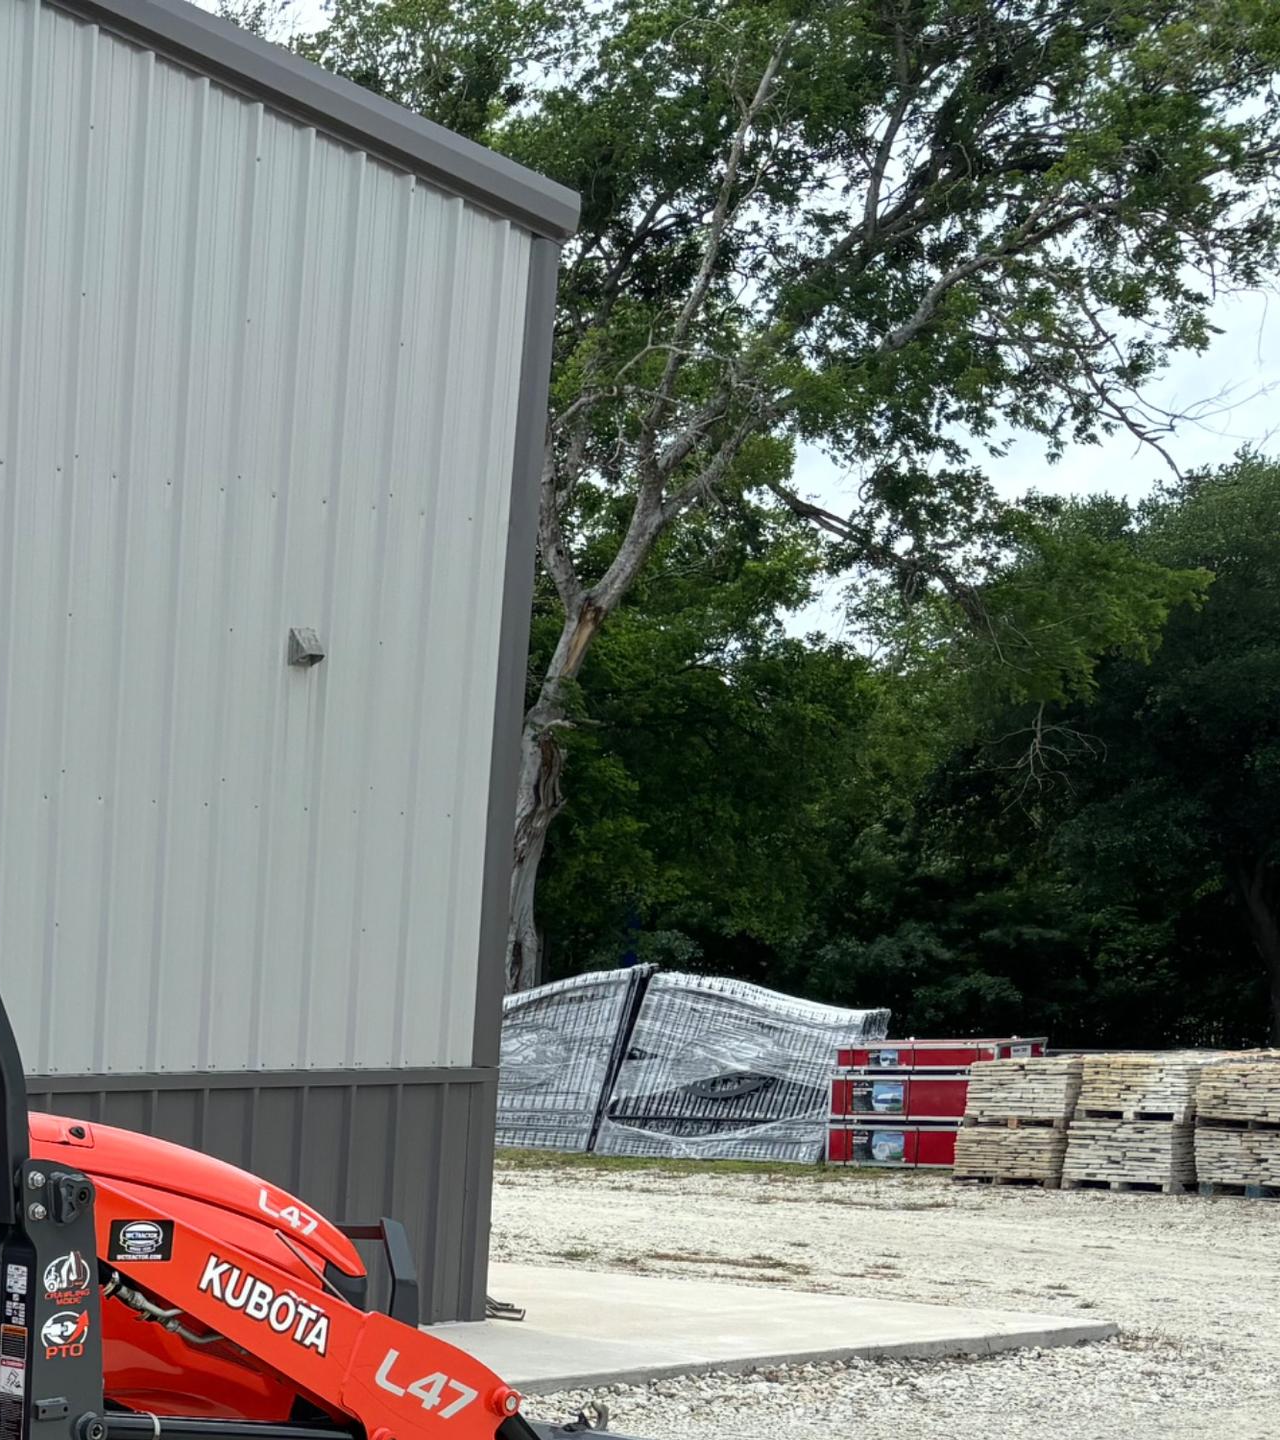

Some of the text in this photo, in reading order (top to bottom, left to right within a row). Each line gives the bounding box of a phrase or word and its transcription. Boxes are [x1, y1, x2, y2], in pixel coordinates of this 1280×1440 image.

[258, 1189, 319, 1237] L47
[200, 1256, 330, 1355] KUBOTA
[46, 1342, 84, 1360] PTO
[375, 1349, 479, 1418] L47
